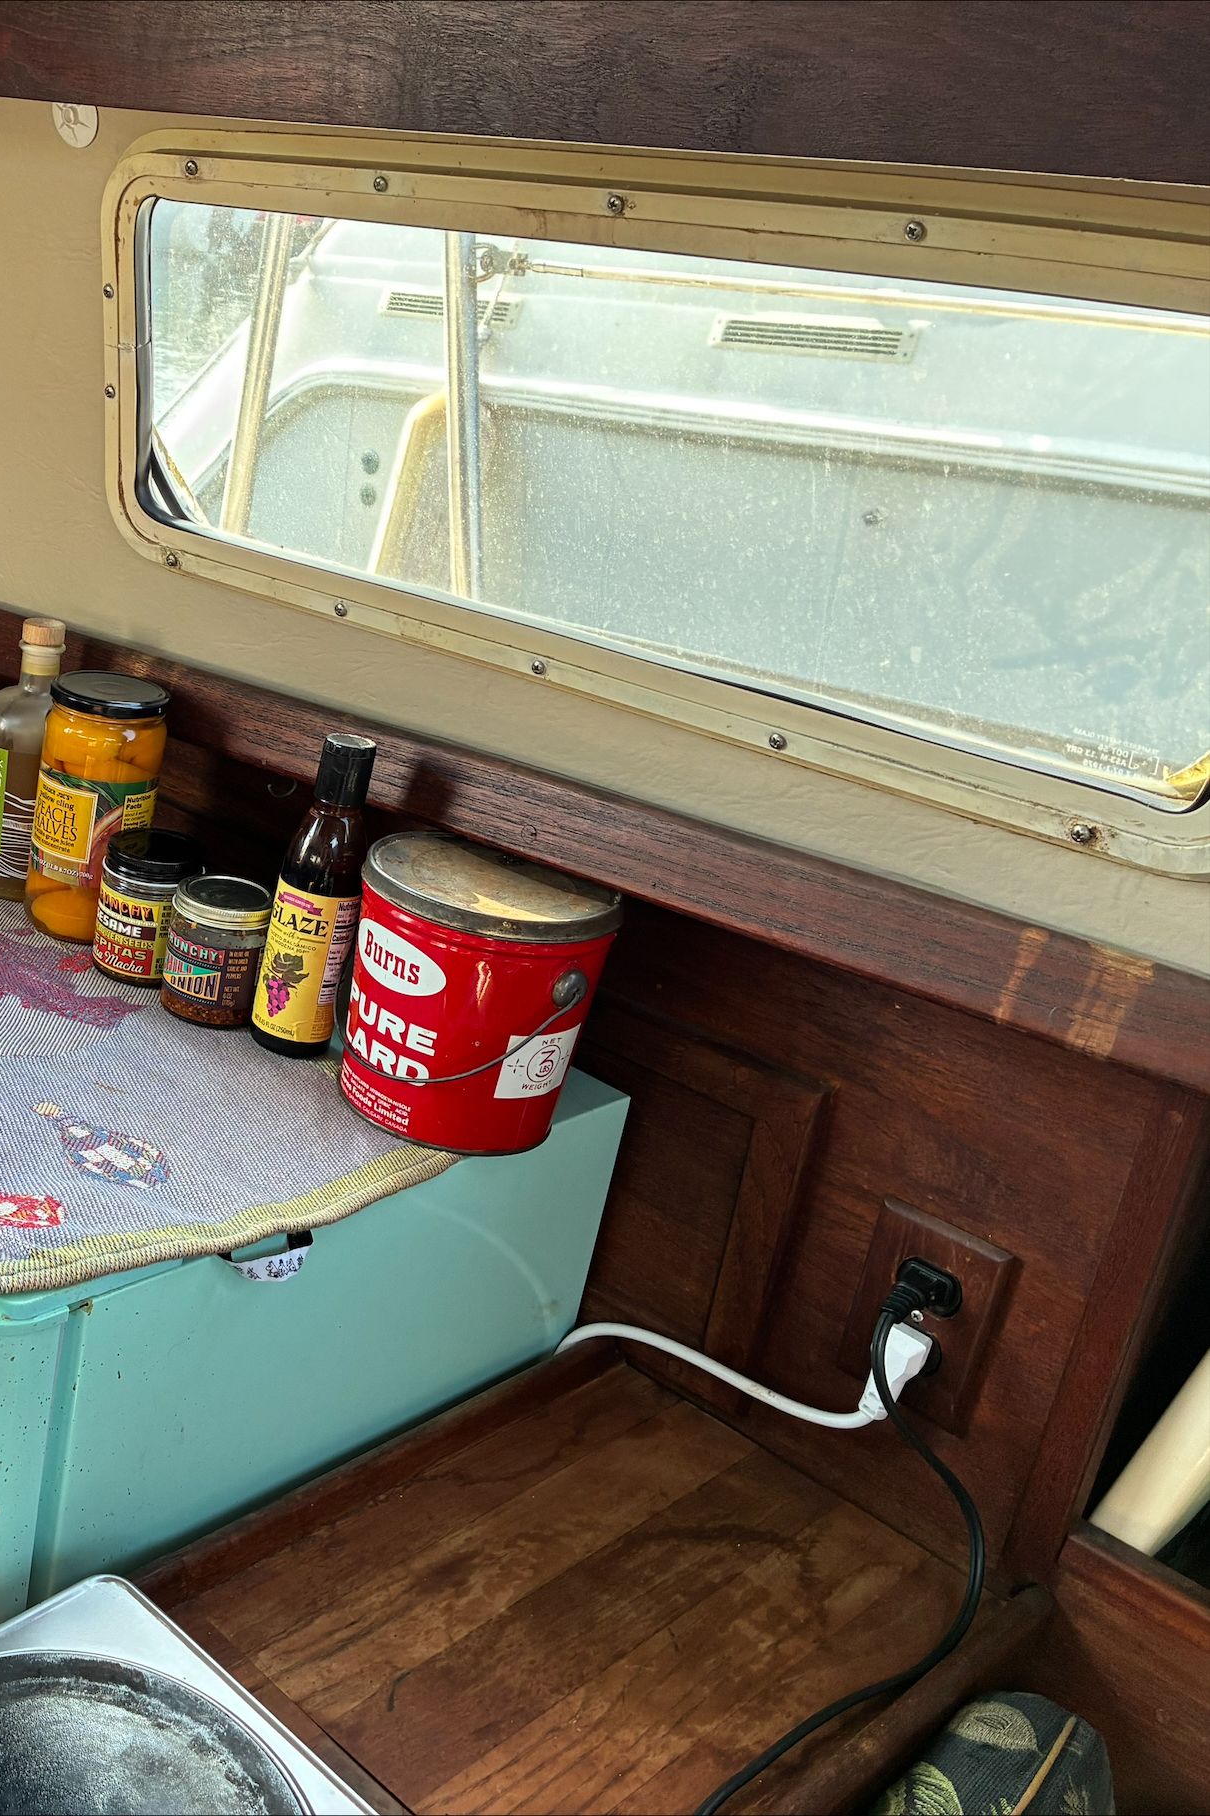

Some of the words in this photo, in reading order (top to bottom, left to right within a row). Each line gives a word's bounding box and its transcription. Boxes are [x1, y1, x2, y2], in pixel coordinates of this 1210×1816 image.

[38, 798, 76, 828] PEACH
[56, 799, 74, 812] cling
[126, 803, 142, 811] Facts
[36, 812, 78, 842] HALVES
[272, 902, 329, 938] GLAZE
[94, 934, 146, 961] EPITAS
[123, 936, 154, 950] SEEDS
[364, 928, 420, 985] Burns
[104, 951, 144, 974] Macha
[170, 974, 217, 999] ONION
[350, 978, 438, 1056] PURE
[346, 1010, 430, 1086] LARD
[542, 1037, 563, 1046] NET
[535, 1049, 556, 1078] 3
[539, 1064, 551, 1074] LBS
[521, 1079, 552, 1090] WEIGHT
[352, 1085, 373, 1108] Foods
[374, 1102, 410, 1127] Limited
